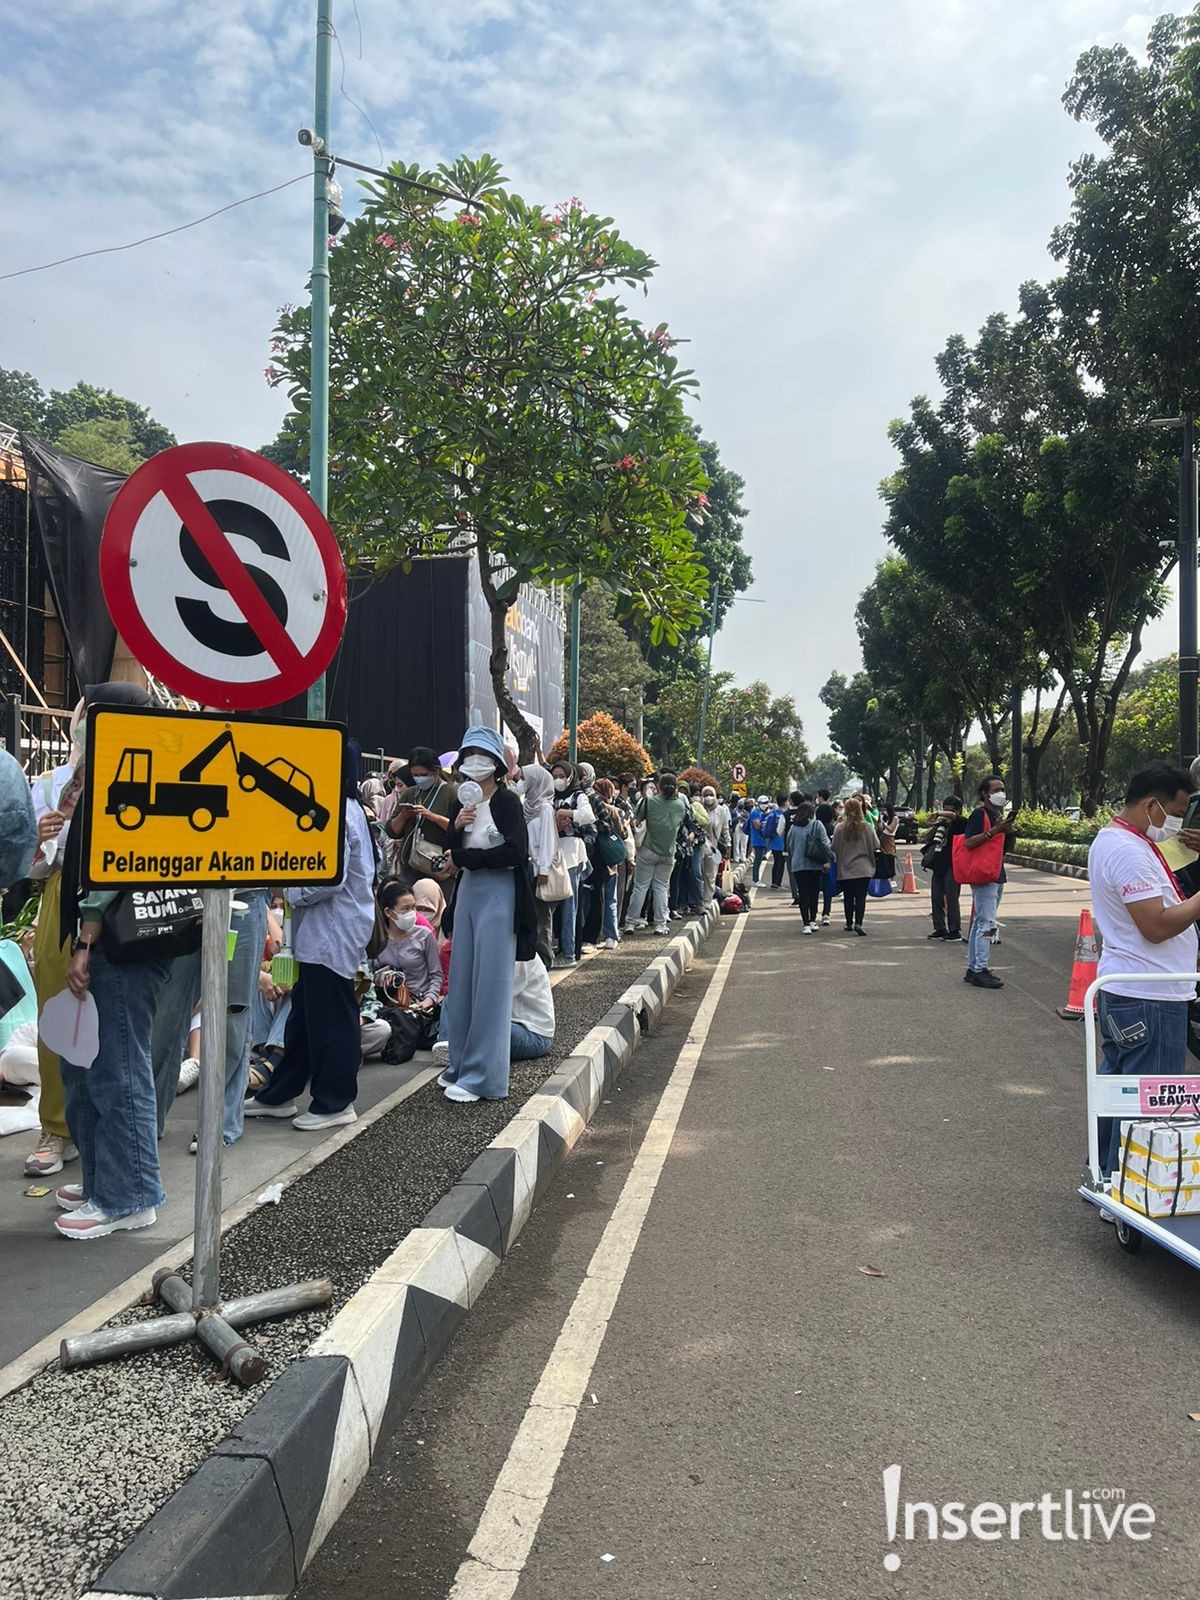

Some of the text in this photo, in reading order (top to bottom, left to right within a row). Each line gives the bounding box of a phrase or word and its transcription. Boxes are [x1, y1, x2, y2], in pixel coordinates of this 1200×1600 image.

[175, 498, 291, 657] S
[102, 850, 327, 877] Pelanggar Akan Diderek
